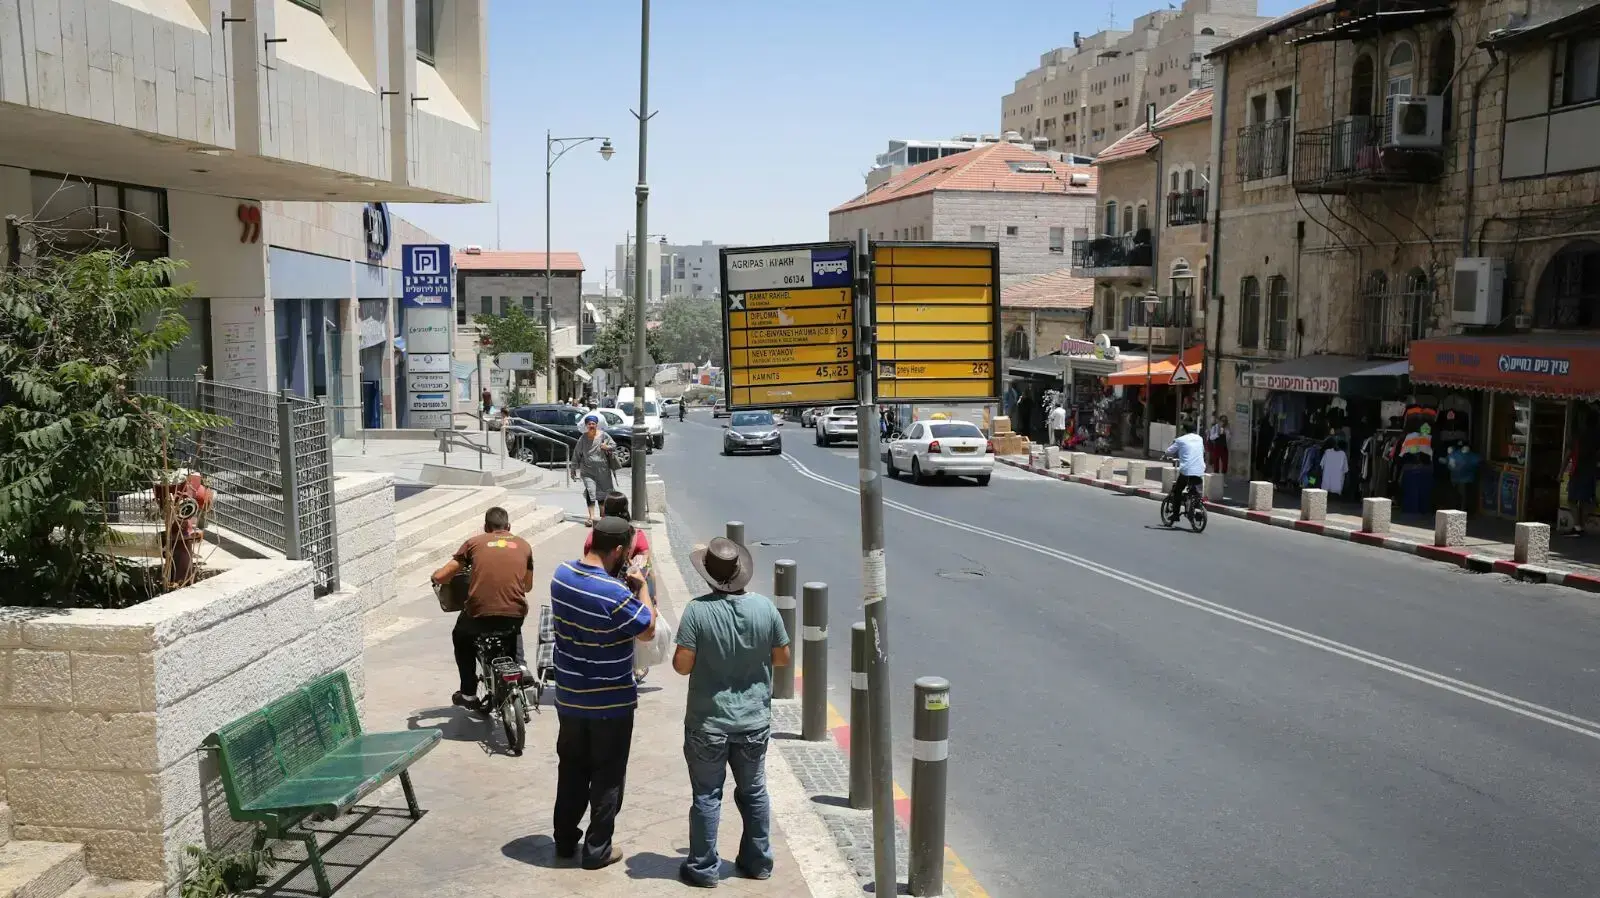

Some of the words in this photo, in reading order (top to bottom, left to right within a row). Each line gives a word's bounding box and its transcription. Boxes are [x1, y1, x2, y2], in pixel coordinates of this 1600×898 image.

[731, 259, 764, 269] AGRIPAS
[405, 276, 448, 286] חניון
[783, 275, 805, 284] 06134
[405, 285, 434, 293] לירושלים
[749, 292, 768, 300] RAMAT
[769, 291, 791, 299] RAKHEL
[840, 290, 847, 301] 7
[841, 328, 848, 339] 9
[751, 349, 768, 358] NEVE
[836, 347, 849, 358] 25
[972, 362, 989, 374] 262
[1534, 359, 1549, 372] פיס
[1550, 360, 1569, 374] צריך
[1267, 377, 1304, 389] ותיקונים
[1306, 378, 1337, 392] תפירה
